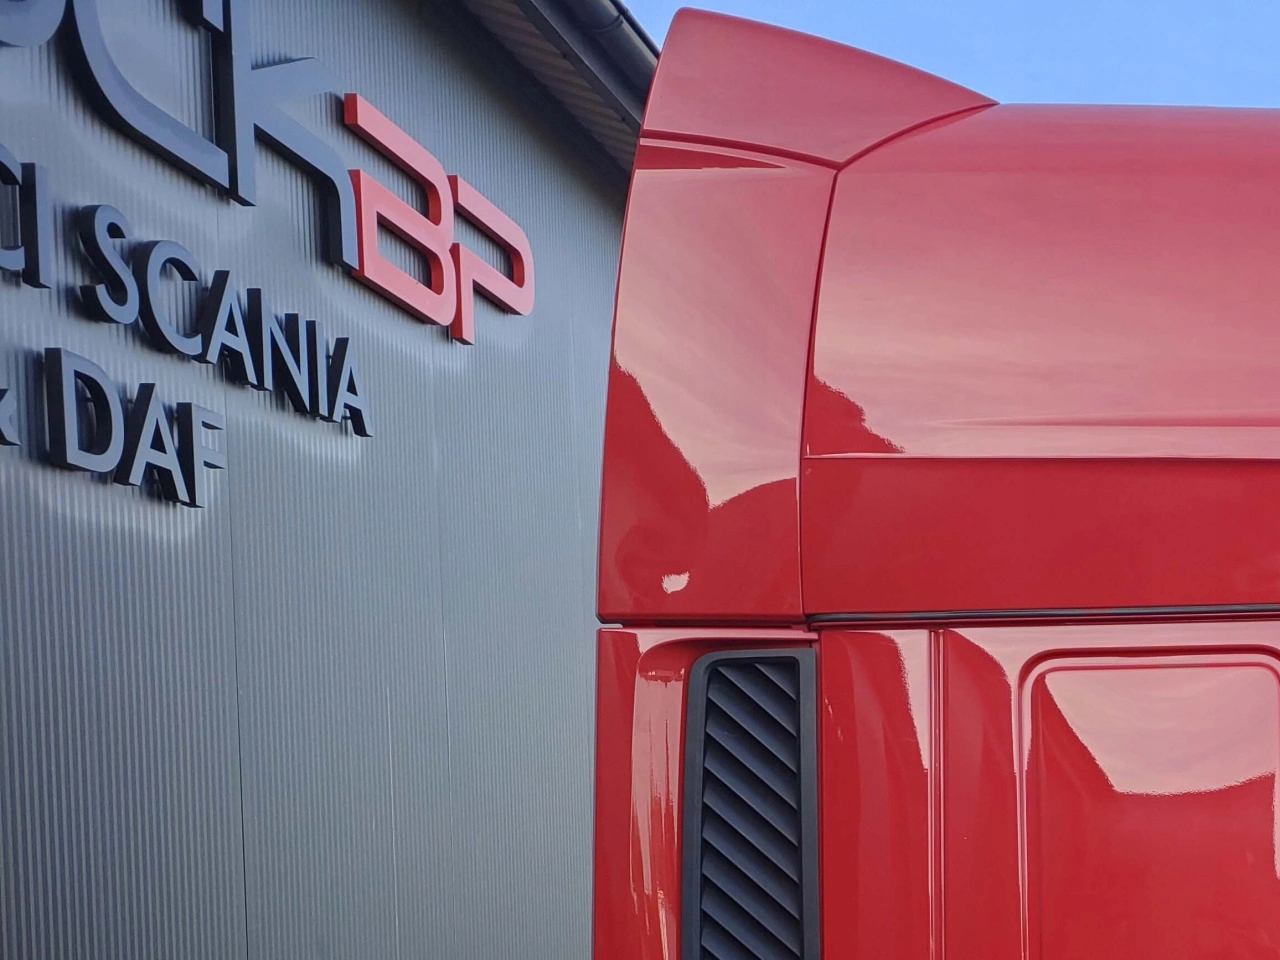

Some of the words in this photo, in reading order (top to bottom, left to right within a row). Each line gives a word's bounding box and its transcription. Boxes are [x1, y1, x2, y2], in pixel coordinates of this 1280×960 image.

[80, 205, 373, 437] SCANIA
[344, 93, 534, 345] BP
[45, 347, 226, 508] DAF
